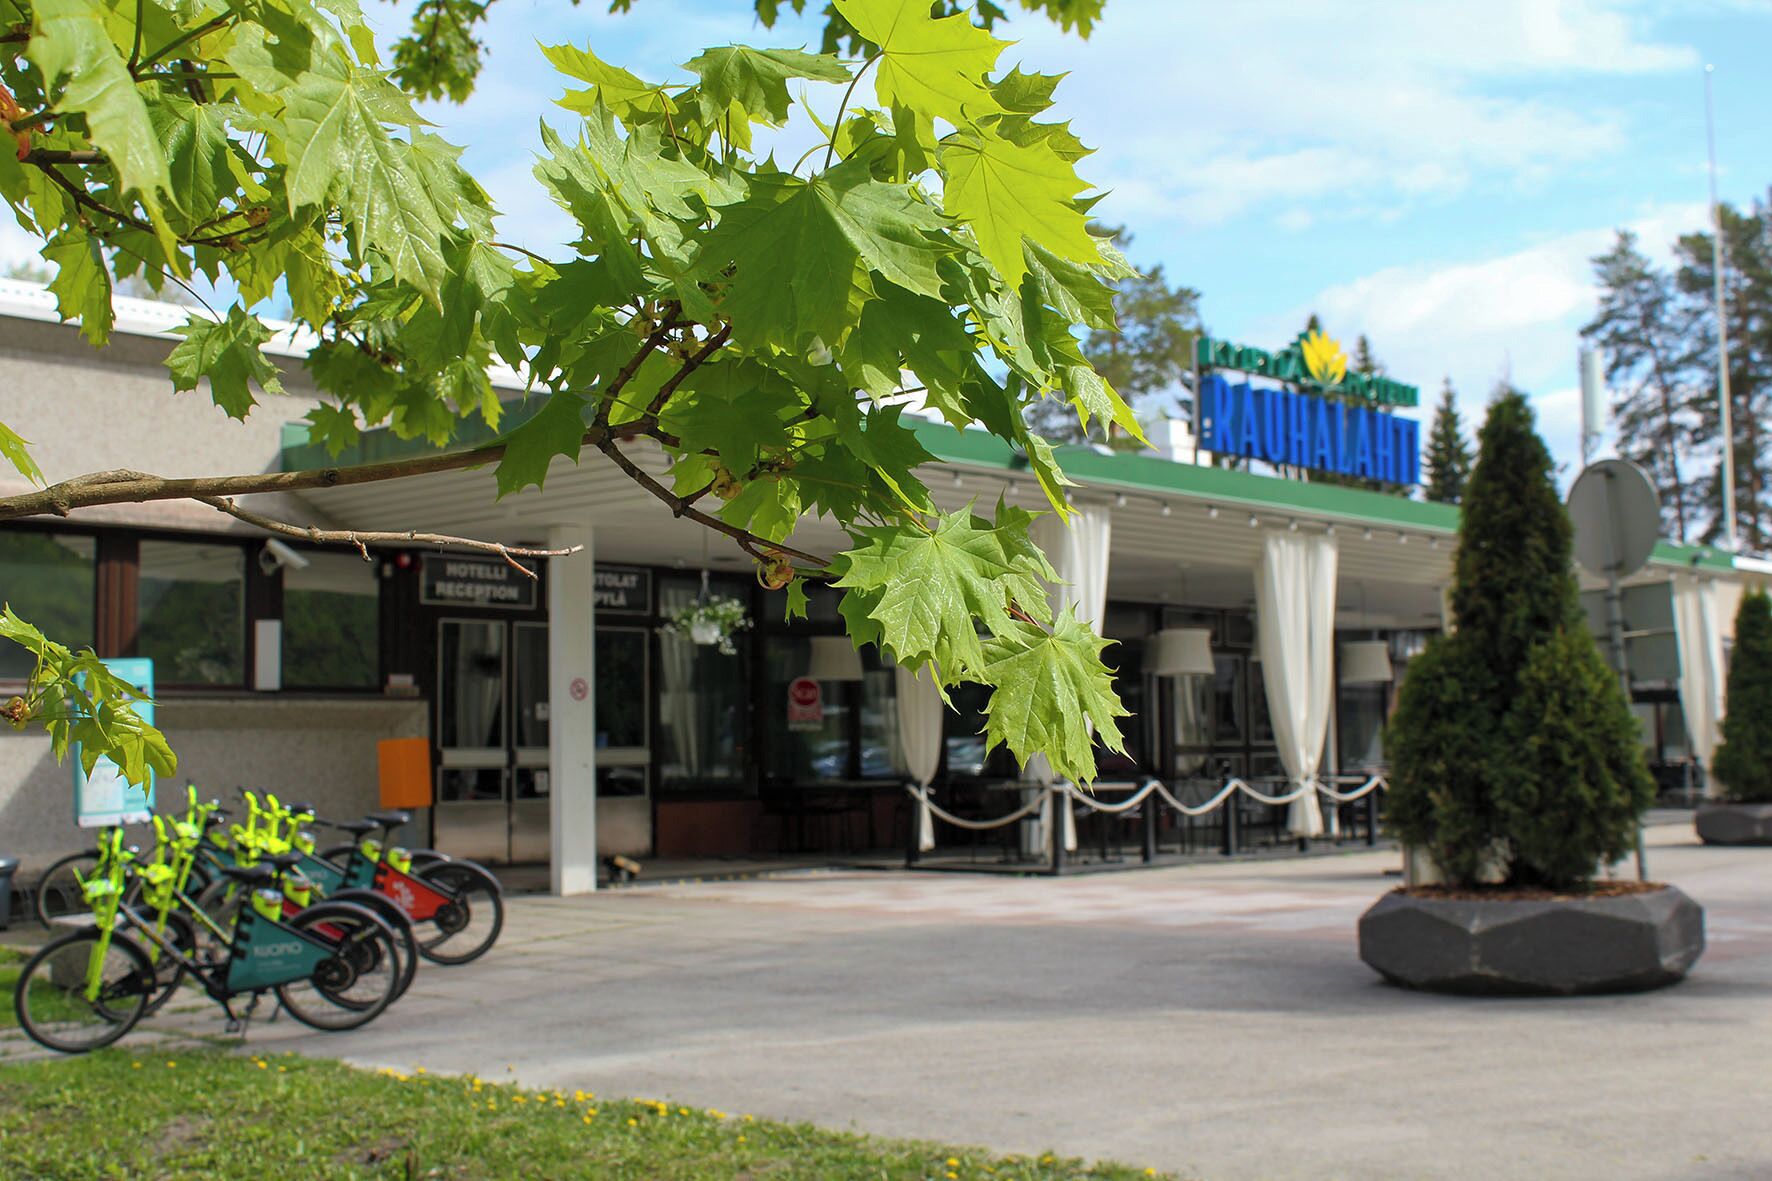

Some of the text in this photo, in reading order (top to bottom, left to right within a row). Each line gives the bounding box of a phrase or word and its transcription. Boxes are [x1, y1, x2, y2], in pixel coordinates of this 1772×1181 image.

[1201, 375, 1420, 484] RAUHALAHTI
[446, 562, 508, 580] HOTELLI
[594, 572, 639, 588] TOLAT
[435, 581, 520, 600] RECEPTION
